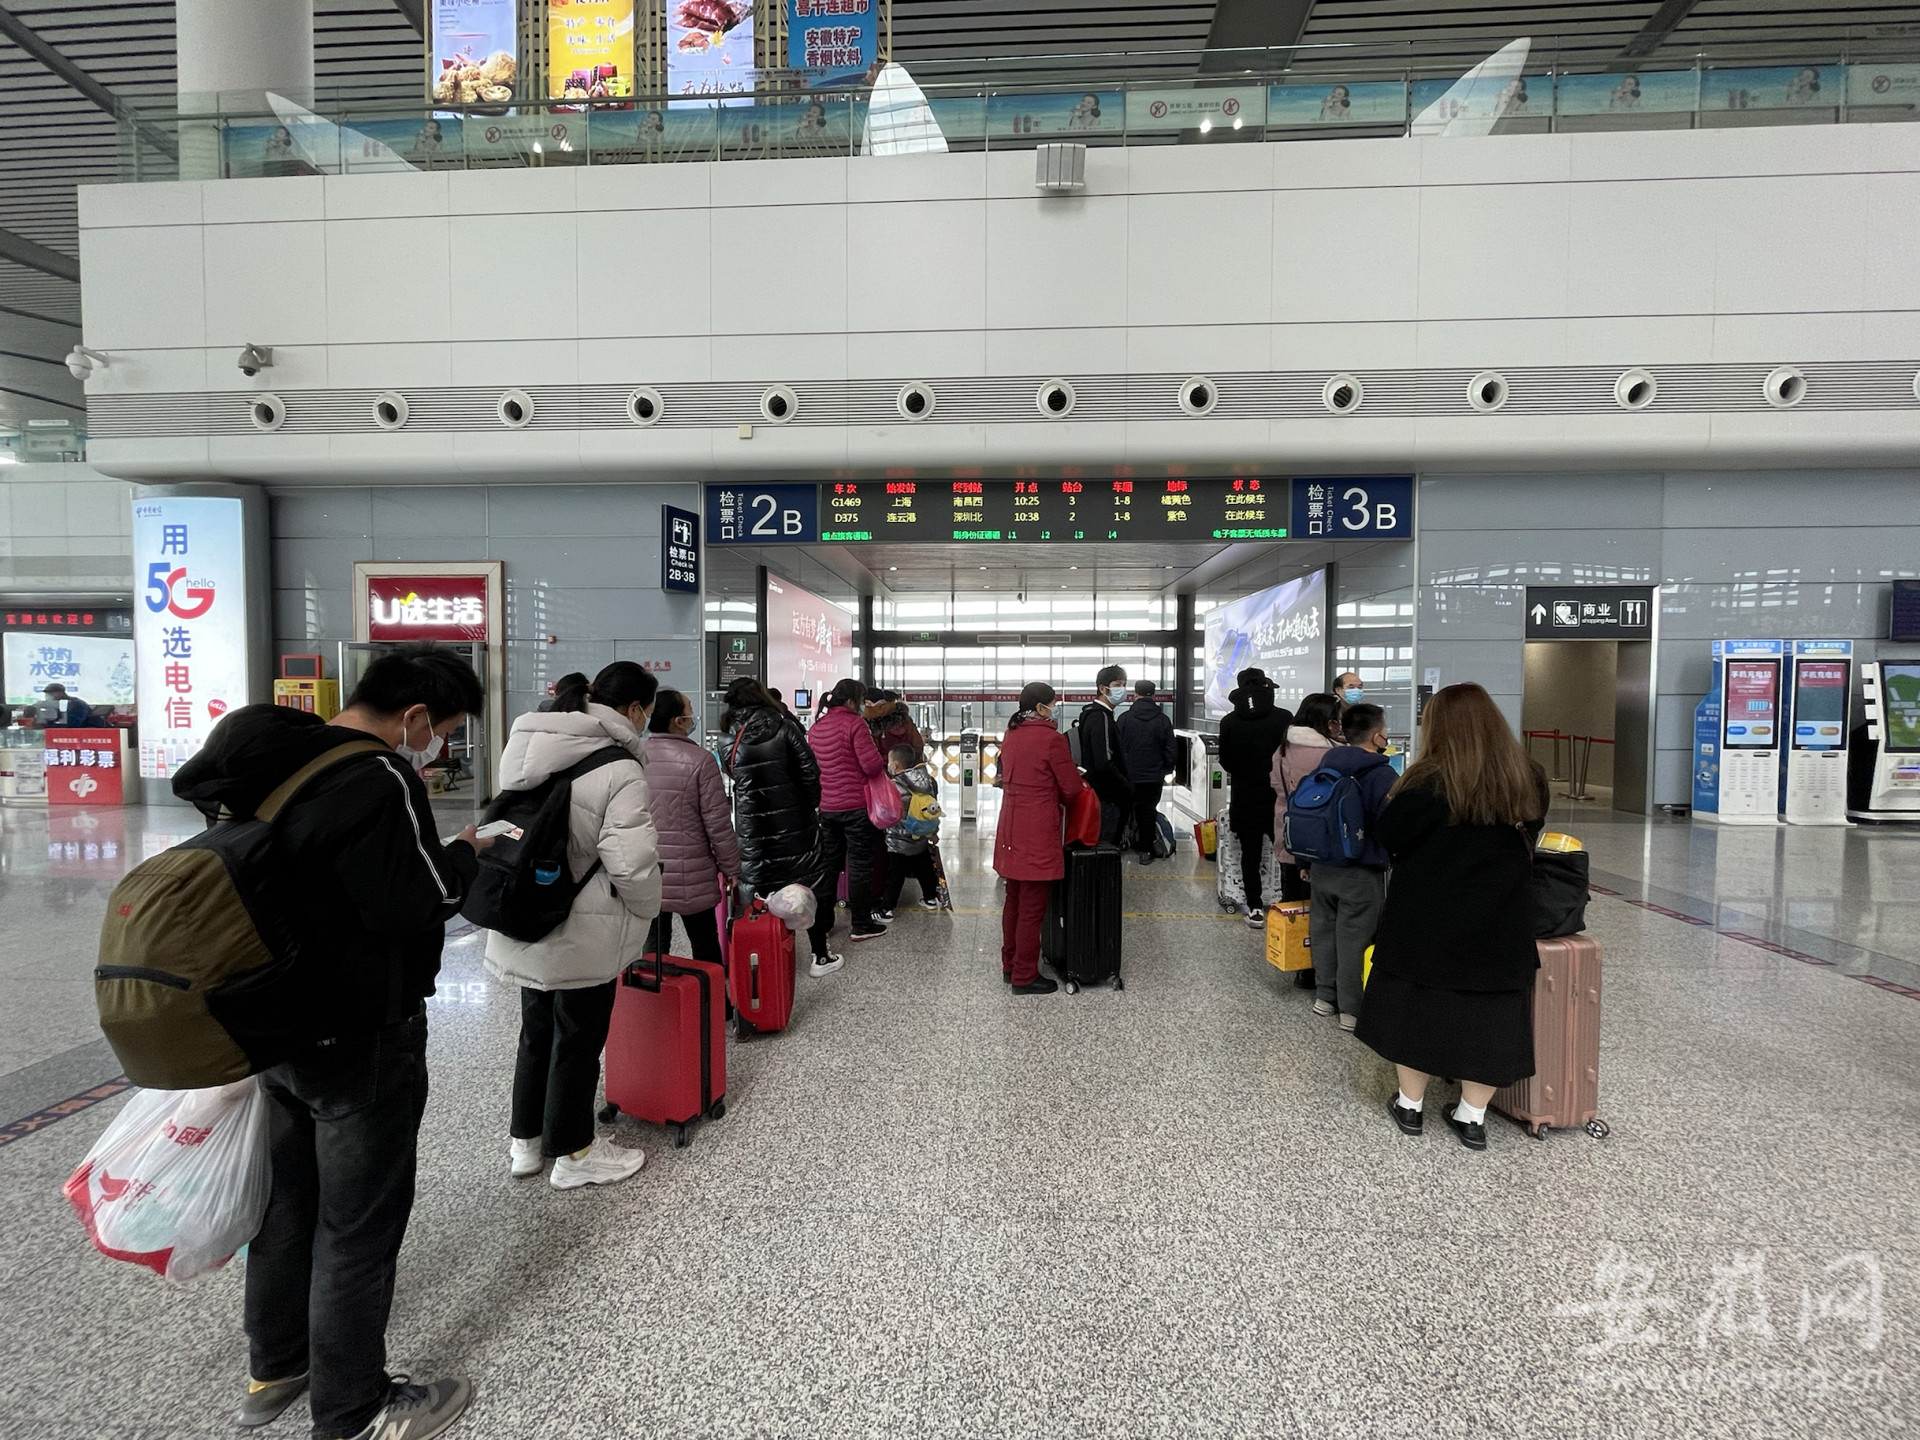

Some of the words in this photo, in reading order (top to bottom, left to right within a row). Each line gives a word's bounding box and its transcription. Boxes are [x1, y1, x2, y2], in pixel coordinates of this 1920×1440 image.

[806, 27, 860, 47] 安徽特产
[806, 47, 860, 67] 香烟饮料
[834, 483, 857, 494] 车次
[886, 482, 916, 494] 始发站
[952, 482, 983, 494] 终到站
[1014, 482, 1039, 493] 开点
[1062, 482, 1083, 493] 站台
[1112, 481, 1133, 493] 车厢
[1232, 480, 1261, 491] 状态
[831, 497, 861, 507] G1469
[891, 496, 912, 507] 上海
[953, 496, 983, 508] 南昌西
[1014, 496, 1040, 506] 10:25
[1069, 496, 1076, 506] 3
[1114, 496, 1131, 505] 1-8
[1225, 494, 1266, 505] 在此候车
[719, 491, 735, 540] 检票口
[835, 513, 859, 523] D375
[886, 512, 916, 523] 连云港
[953, 511, 983, 522] 深圳北
[1014, 512, 1040, 522] 10:38
[1069, 512, 1076, 522] 2
[1114, 512, 1131, 521] 1-8
[1166, 510, 1188, 521] 紫色
[1225, 510, 1266, 521] 在此候车
[1307, 484, 1324, 535] 检票口
[160, 524, 188, 556] 用
[669, 546, 696, 563] 检票口
[671, 559, 687, 569] Check
[145, 561, 215, 620] 5G
[186, 577, 215, 588] hello
[373, 596, 484, 626] U选生活
[1582, 603, 1611, 617] 商业
[38, 646, 73, 662] 节约
[724, 653, 754, 661] 人工通道
[30, 661, 81, 680] 水资源
[1730, 670, 1772, 679] 手机充电站
[1800, 670, 1842, 679] 手机充电站
[42, 748, 116, 768] 福利彩票
